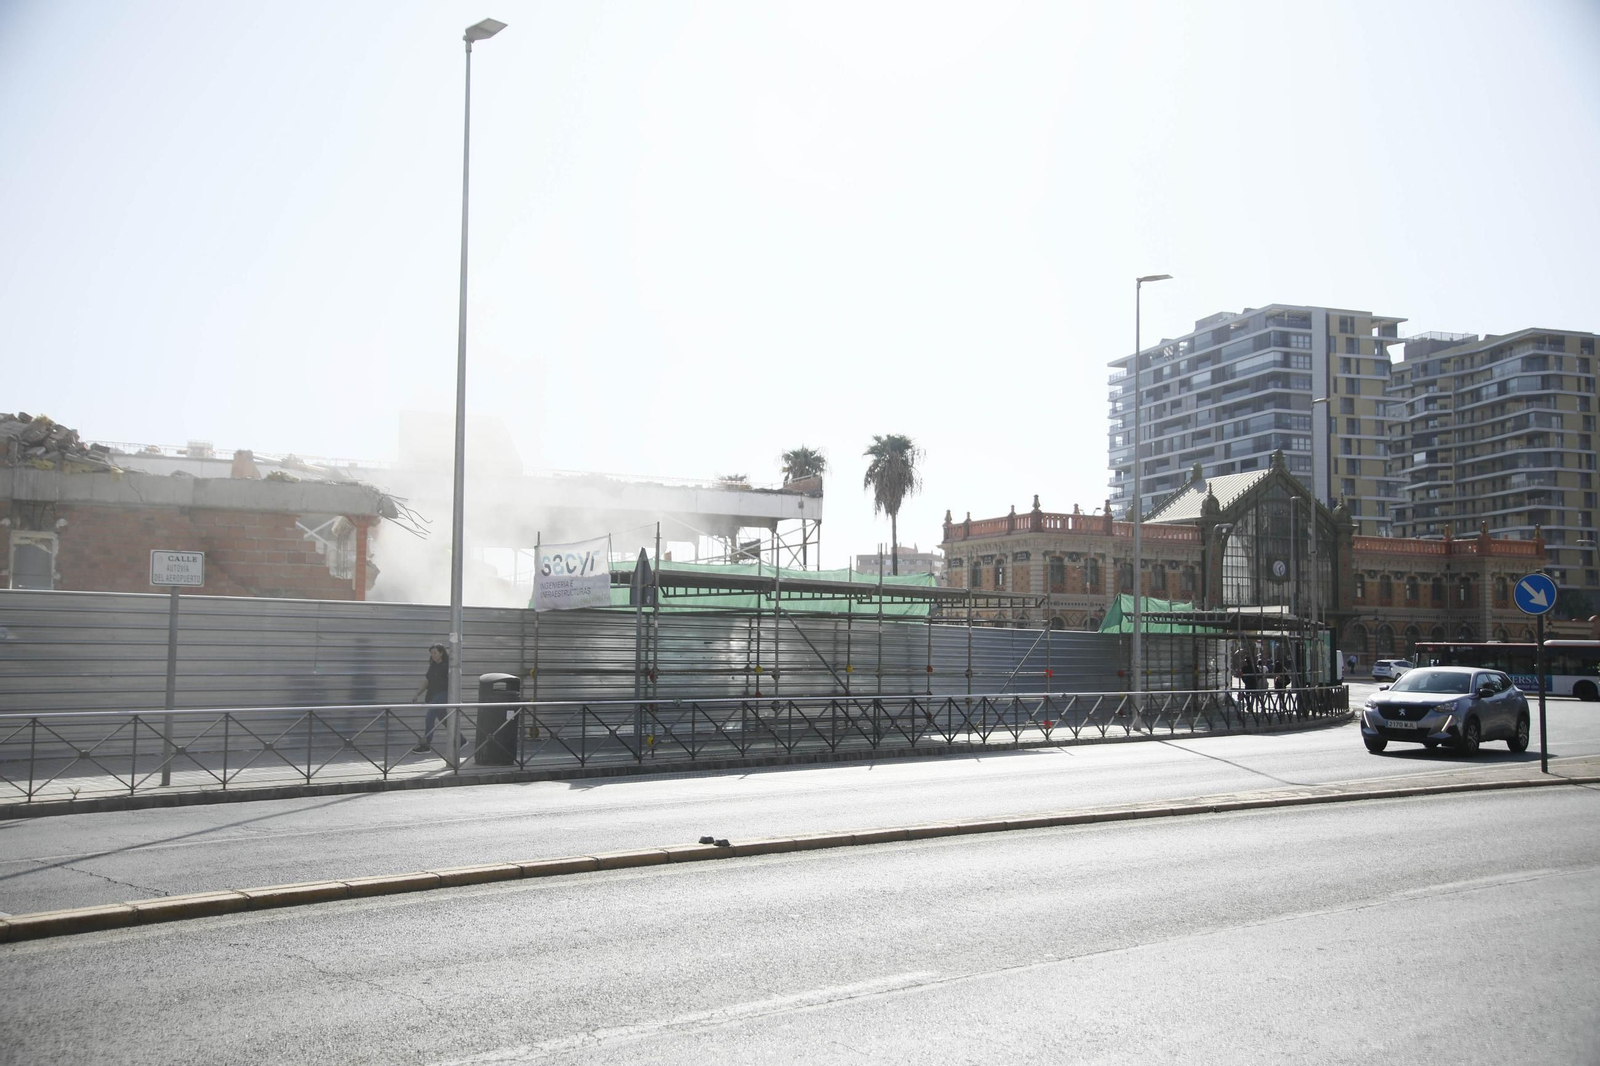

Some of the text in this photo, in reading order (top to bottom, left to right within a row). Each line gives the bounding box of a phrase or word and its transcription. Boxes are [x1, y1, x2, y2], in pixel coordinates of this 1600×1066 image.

[168, 555, 198, 563] CALLE
[541, 550, 600, 577] sacyr
[154, 573, 201, 583] DEL AEROPUERTO
[540, 587, 591, 599] INFRAESTRUCTURAS
